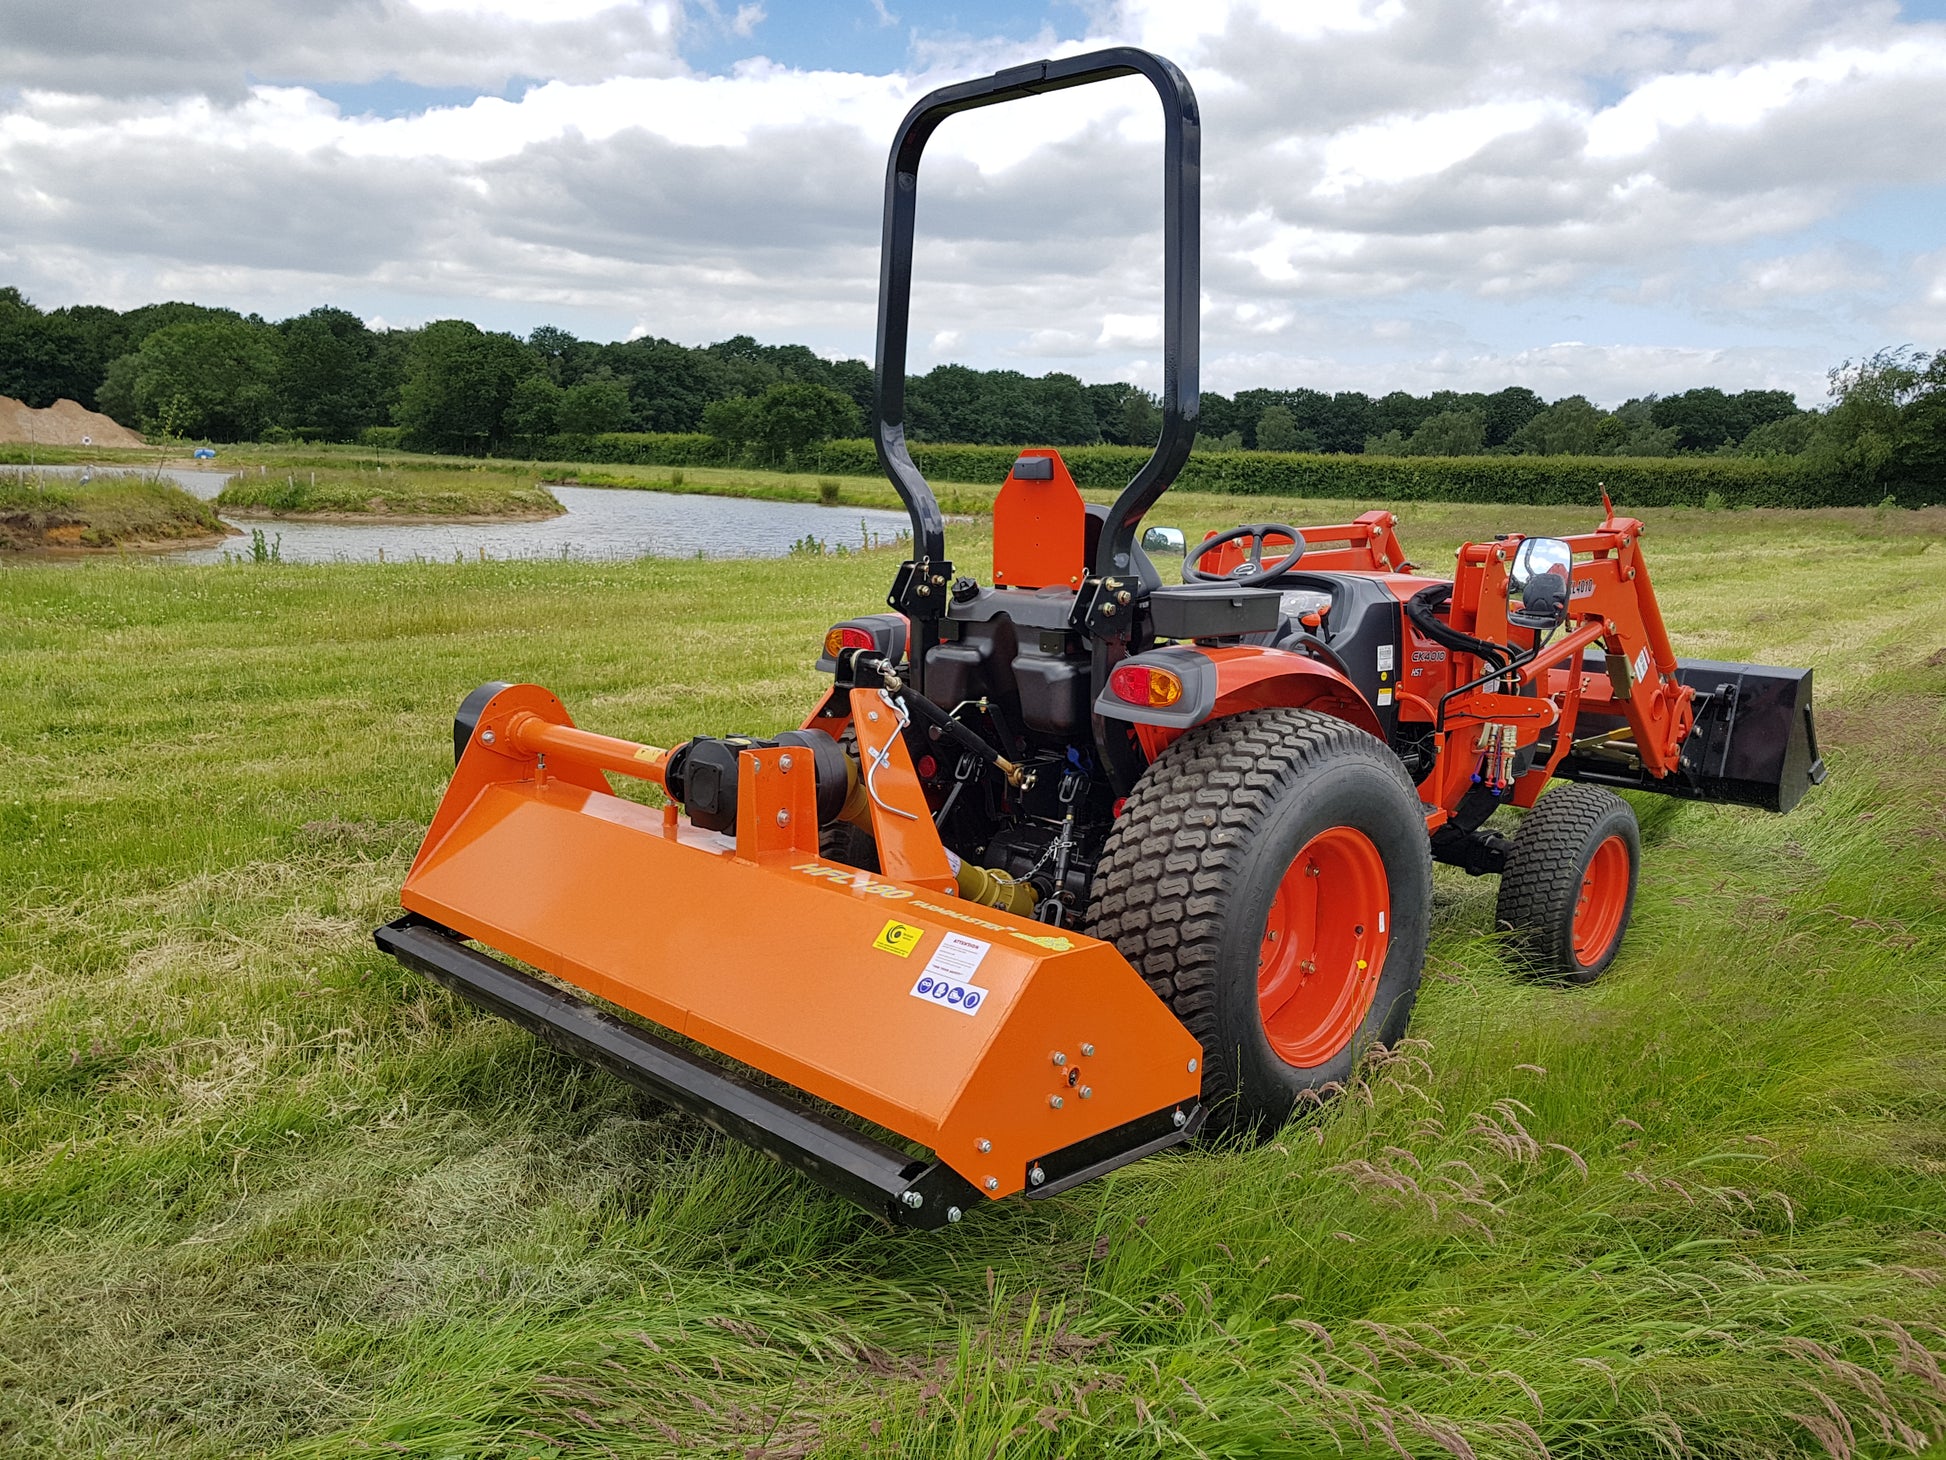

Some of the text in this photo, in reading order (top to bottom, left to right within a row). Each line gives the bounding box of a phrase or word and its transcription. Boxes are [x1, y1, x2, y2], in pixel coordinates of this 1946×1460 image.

[1570, 578, 1593, 595] L4010
[1411, 650, 1446, 662] CK4010
[1411, 668, 1423, 677] HST
[953, 939, 980, 949] ATTENTION
